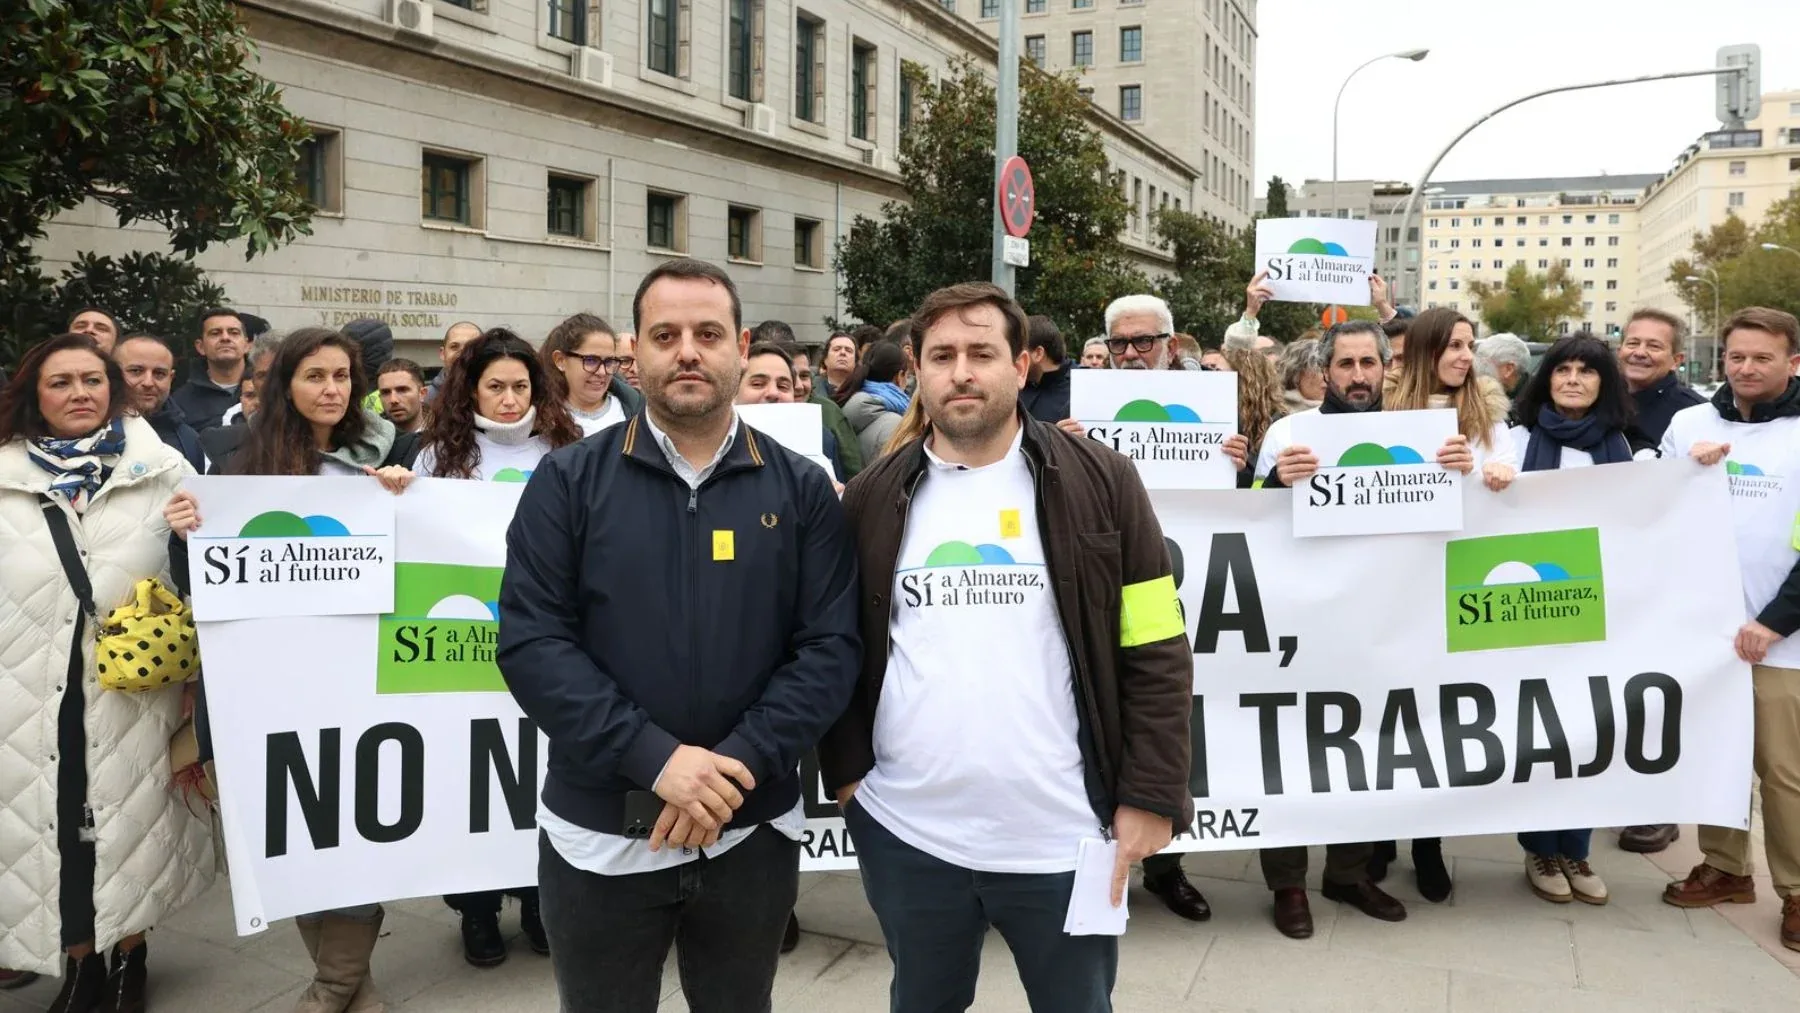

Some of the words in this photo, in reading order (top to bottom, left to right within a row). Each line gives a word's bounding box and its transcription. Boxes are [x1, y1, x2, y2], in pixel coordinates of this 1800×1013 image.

[1266, 257, 1294, 281] Sí
[1298, 260, 1307, 269] a
[1310, 256, 1367, 275] Almaraz,
[1298, 269, 1311, 281] al
[1315, 270, 1354, 284] futuro
[300, 285, 381, 305] MINISTERIO
[386, 290, 402, 305] DE
[407, 291, 458, 307] TRABAJO
[320, 310, 328, 325] Y
[401, 313, 442, 328] SOCIAL
[1130, 431, 1139, 443] a
[1129, 445, 1146, 460] al
[1152, 444, 1209, 461] futuro
[1309, 473, 1346, 507] Sí
[1353, 475, 1365, 488] a
[1371, 470, 1453, 487] Almaraz,
[1353, 489, 1371, 505] al
[1377, 488, 1434, 504] futuro
[204, 544, 250, 586] Sí
[259, 548, 274, 563] a
[280, 543, 384, 564] Almaraz,
[259, 563, 280, 583] al
[287, 563, 361, 582] futuro
[901, 572, 934, 608] Sí
[941, 575, 952, 588] a
[958, 569, 1044, 590] Almaraz,
[942, 588, 959, 606] al
[966, 587, 1025, 606] futuro
[1459, 591, 1493, 626] Sí
[1501, 593, 1512, 606] a
[1517, 587, 1598, 605] Almaraz,
[1501, 606, 1518, 623] al
[1524, 604, 1581, 621] futuro
[394, 625, 438, 663] Sí
[445, 629, 459, 643] a
[445, 644, 464, 662] al
[1239, 671, 1683, 795] TRABAJO
[265, 721, 424, 859] NO
[800, 828, 857, 859] RAL
